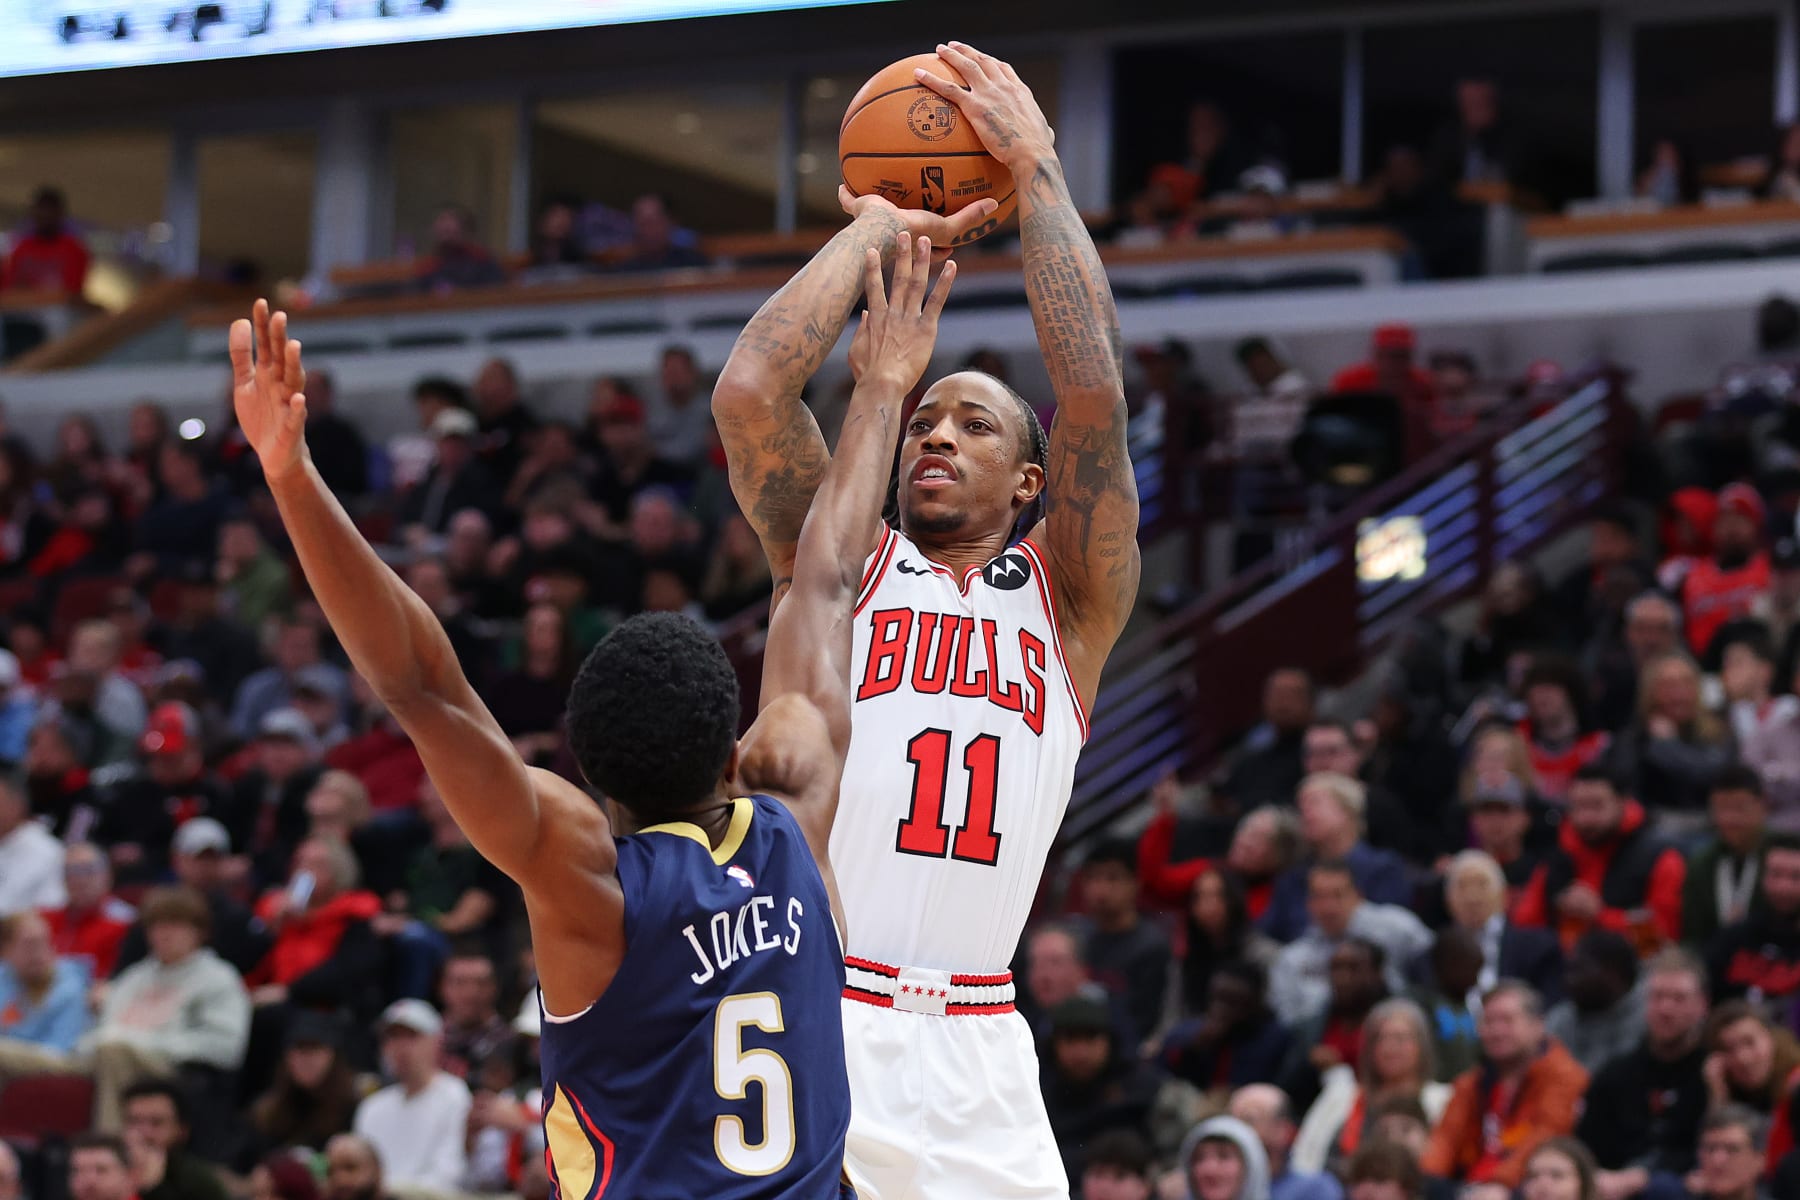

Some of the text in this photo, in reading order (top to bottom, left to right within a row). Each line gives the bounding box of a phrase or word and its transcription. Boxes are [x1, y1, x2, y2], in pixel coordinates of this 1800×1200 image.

[950, 188, 962, 197] BALL
[962, 187, 975, 195] GAME
[855, 607, 1046, 738] BULLS
[896, 727, 1002, 867] 11
[713, 991, 796, 1177] 5
